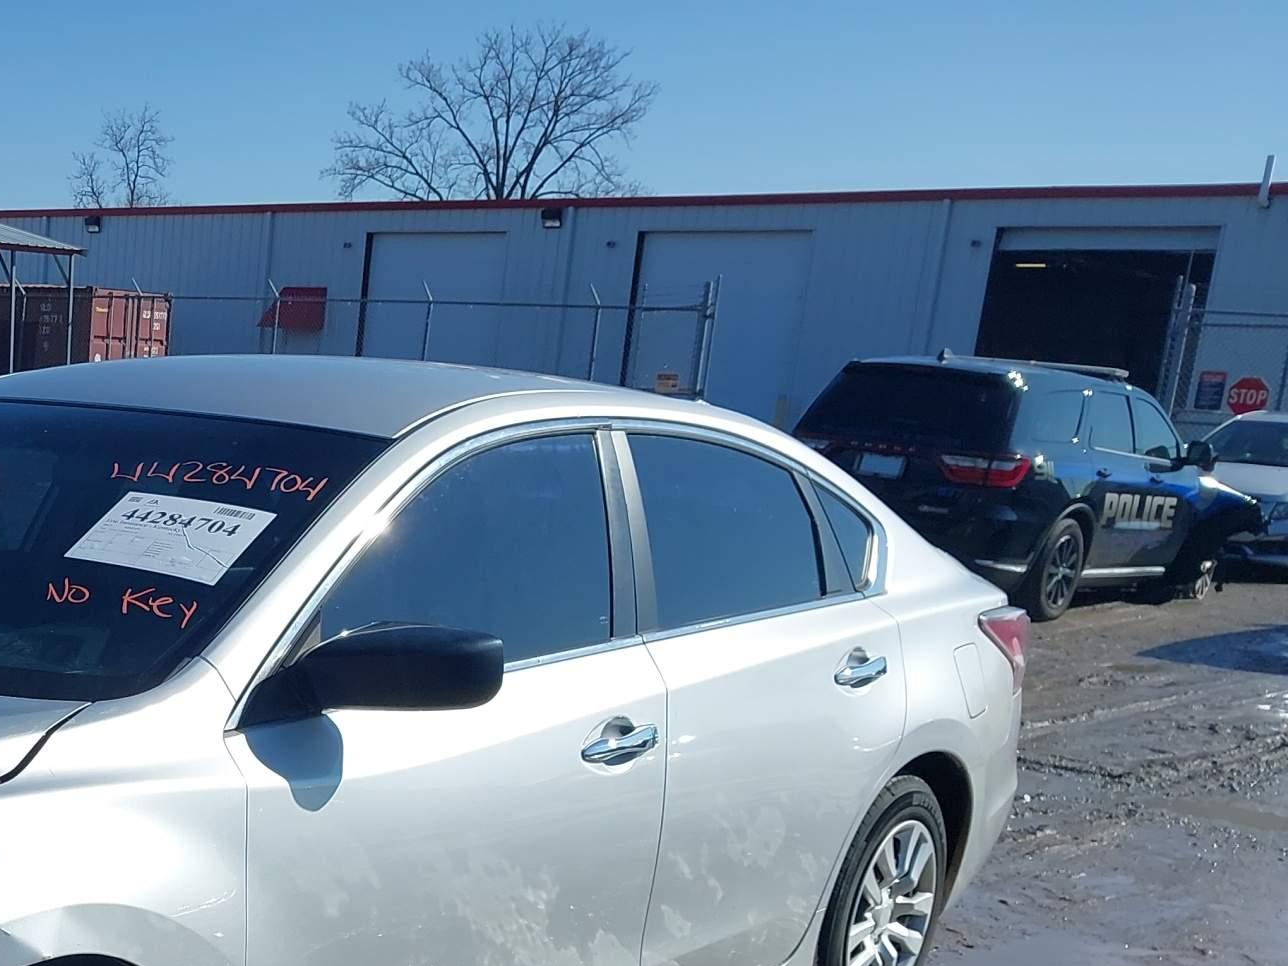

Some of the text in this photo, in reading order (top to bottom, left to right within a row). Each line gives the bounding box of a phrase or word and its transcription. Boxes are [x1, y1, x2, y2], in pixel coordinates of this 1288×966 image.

[1229, 388, 1268, 405] STOP
[111, 461, 328, 501] 44284704
[121, 508, 241, 537] 44284704
[1100, 492, 1178, 528] POLICE
